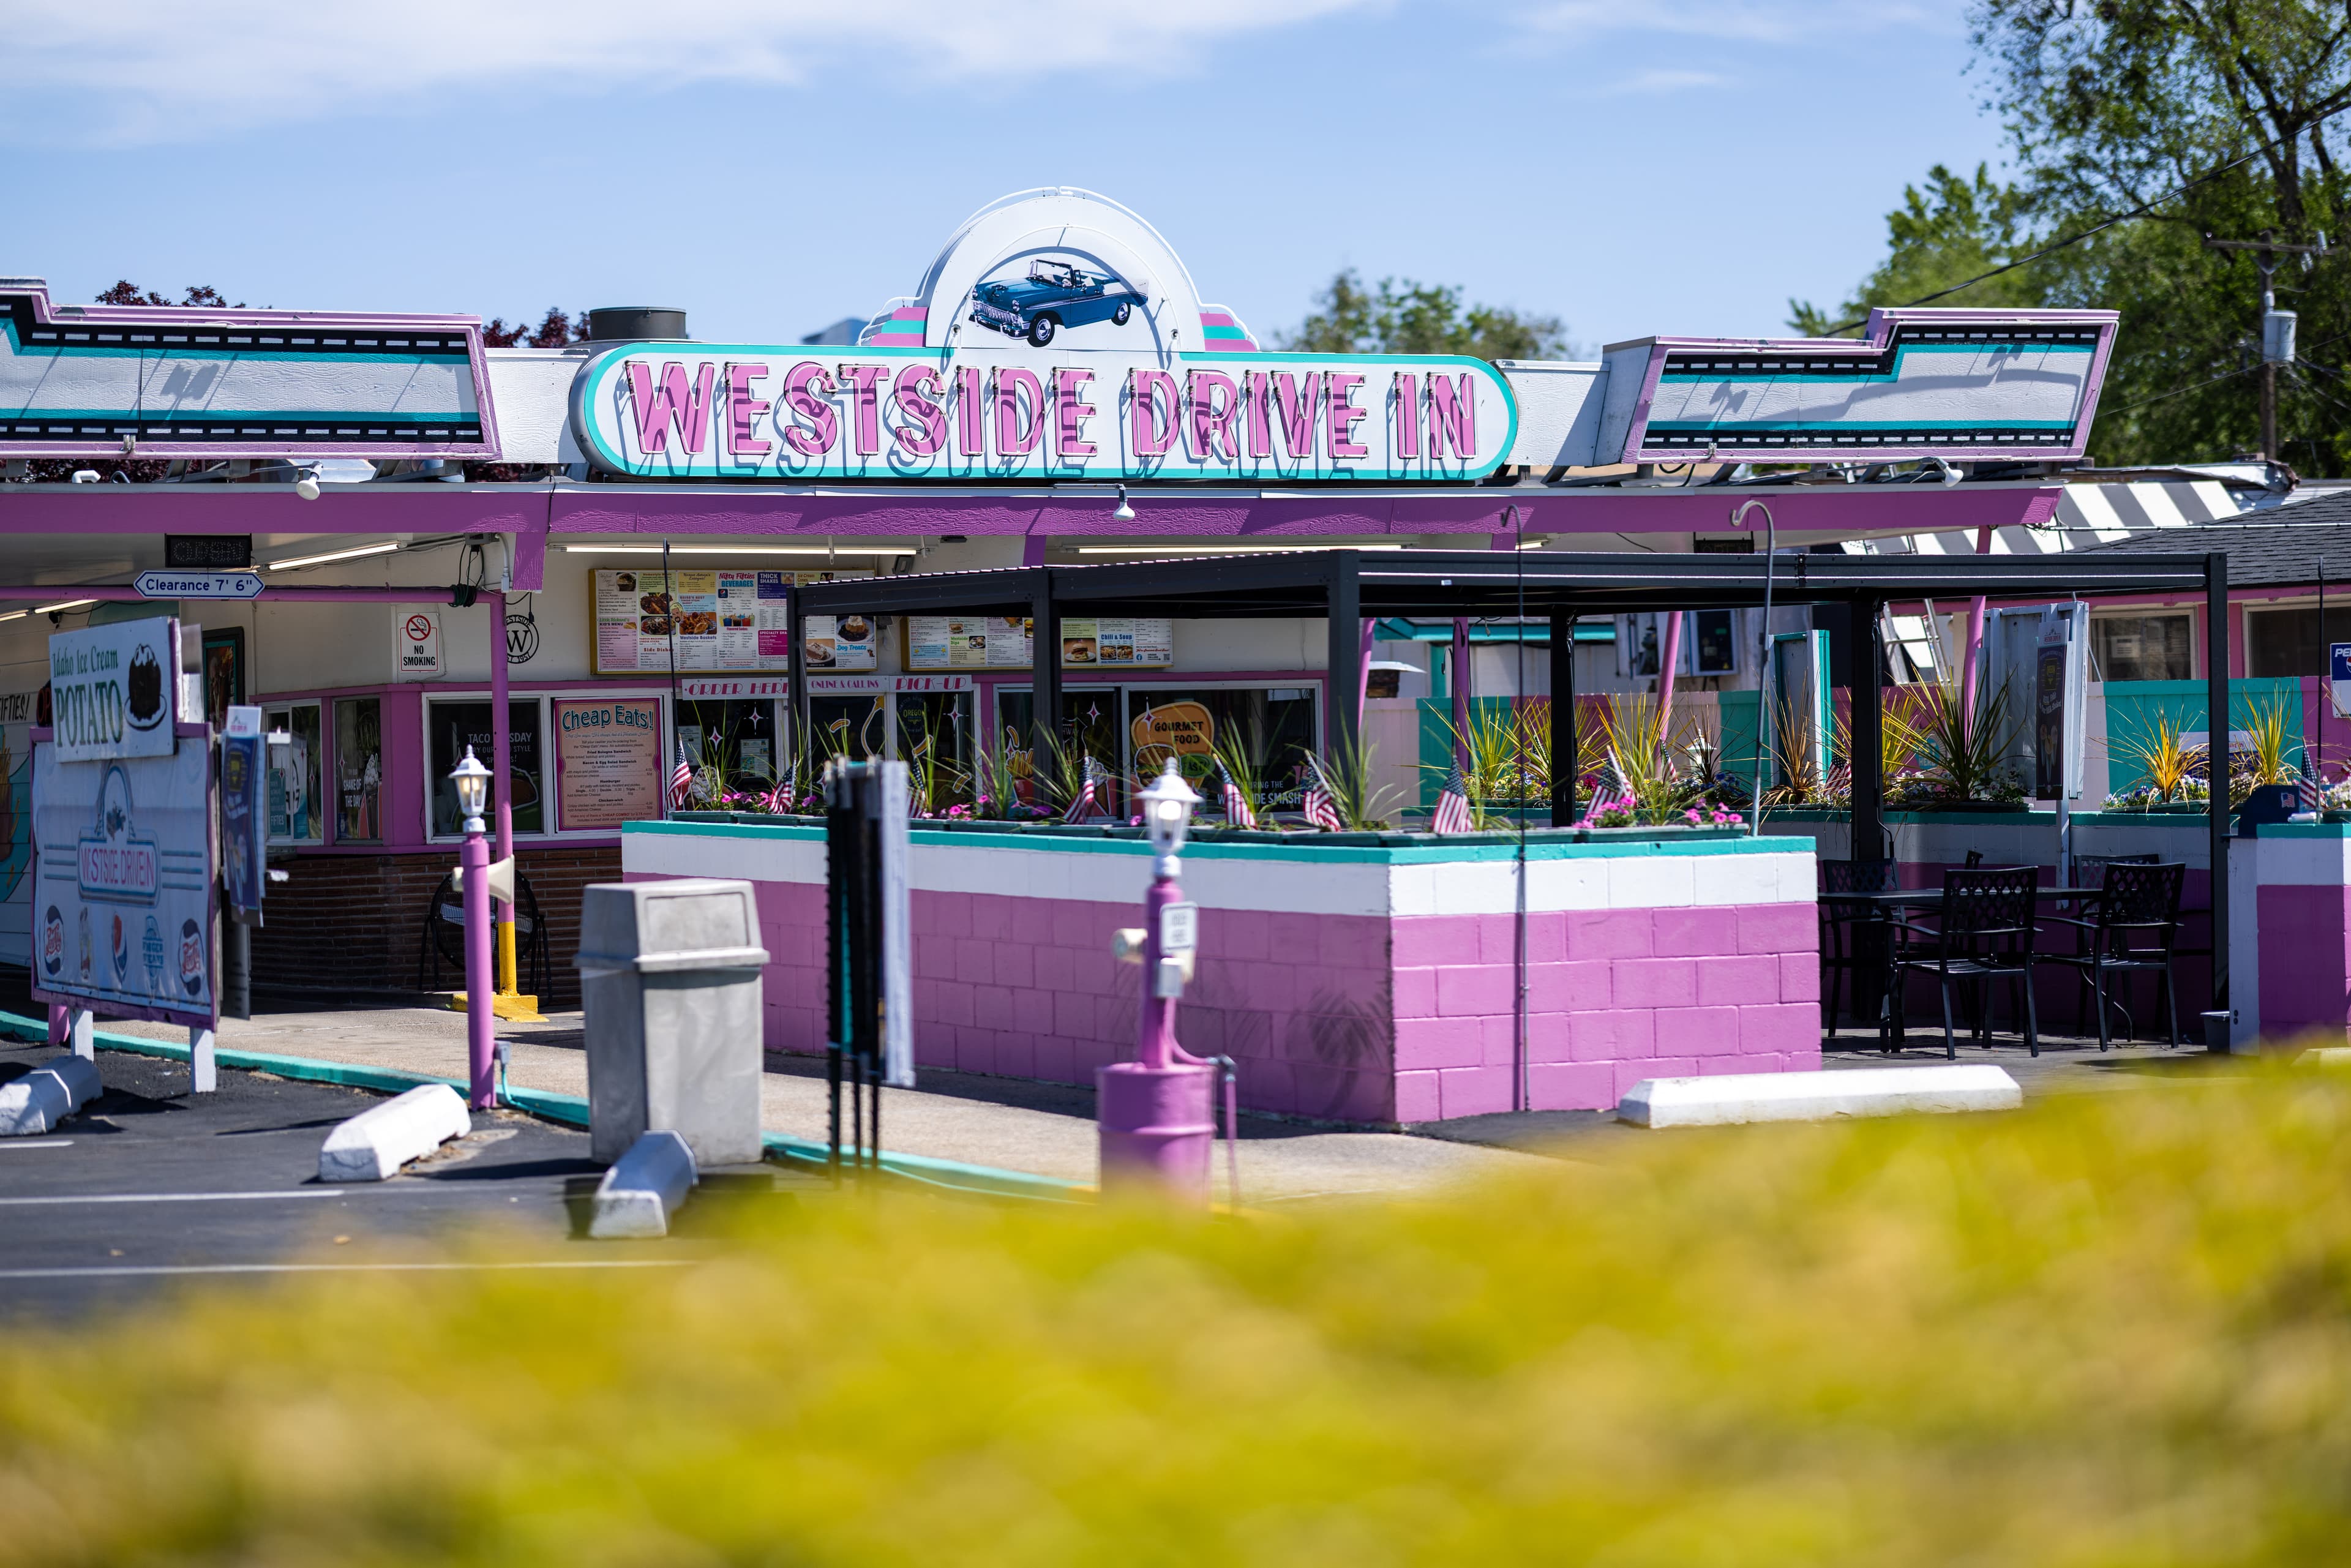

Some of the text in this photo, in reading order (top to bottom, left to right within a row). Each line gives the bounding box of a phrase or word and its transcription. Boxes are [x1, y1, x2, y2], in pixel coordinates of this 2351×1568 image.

[624, 360, 1479, 460] WESTSIDE DRIVE IN
[146, 579, 252, 591] Clearance 7' 6"
[506, 631, 530, 653] W
[414, 645, 424, 655] NO
[53, 645, 119, 678] Idaho Ice Cream
[403, 657, 435, 666] SMOKING
[689, 684, 743, 696] ORDER
[811, 679, 880, 689] ONLINE & CALL INS
[895, 677, 967, 691] PICK-UP
[0, 694, 30, 721] IFTIES!
[54, 680, 124, 748] POTATO
[561, 704, 654, 731] Cheap Eats!
[1155, 721, 1204, 732] GOURMET
[467, 733, 491, 743] TACO
[1174, 735, 1200, 744] FOOD
[343, 778, 362, 791] SHAKE OF
[353, 795, 361, 808] DAY
[1269, 792, 1301, 805] SMASH
